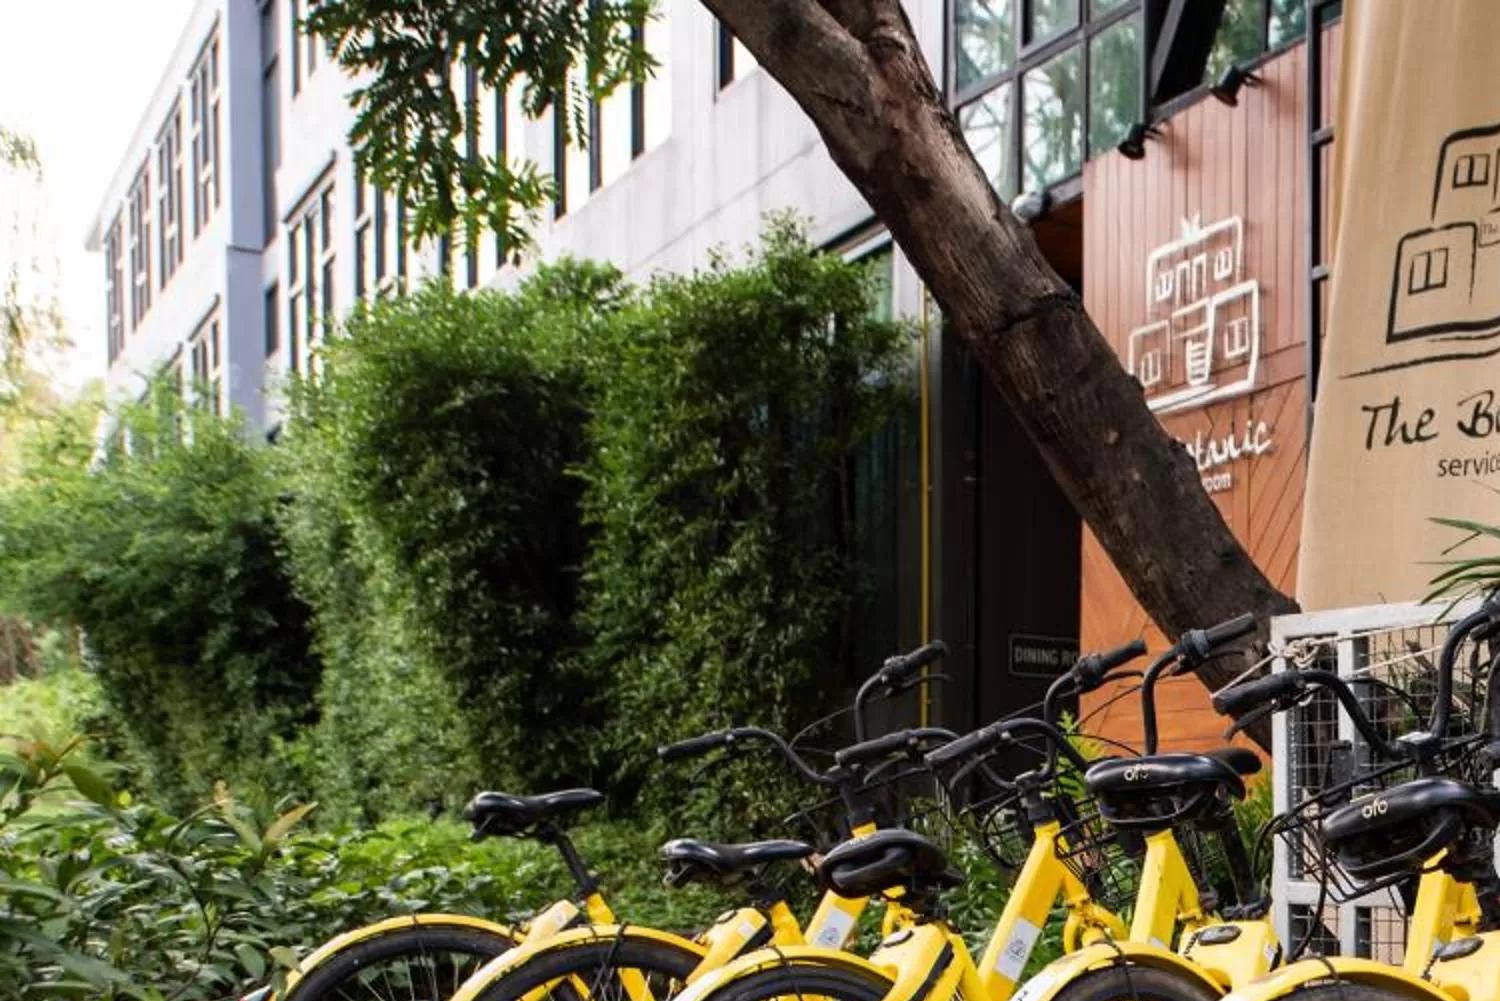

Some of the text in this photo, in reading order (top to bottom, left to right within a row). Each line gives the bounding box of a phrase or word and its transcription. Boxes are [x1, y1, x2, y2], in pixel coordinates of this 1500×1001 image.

[1361, 395, 1440, 450] The
[1184, 420, 1272, 472] tanic
[1201, 473, 1231, 494] oom
[1361, 798, 1389, 818] ofo
